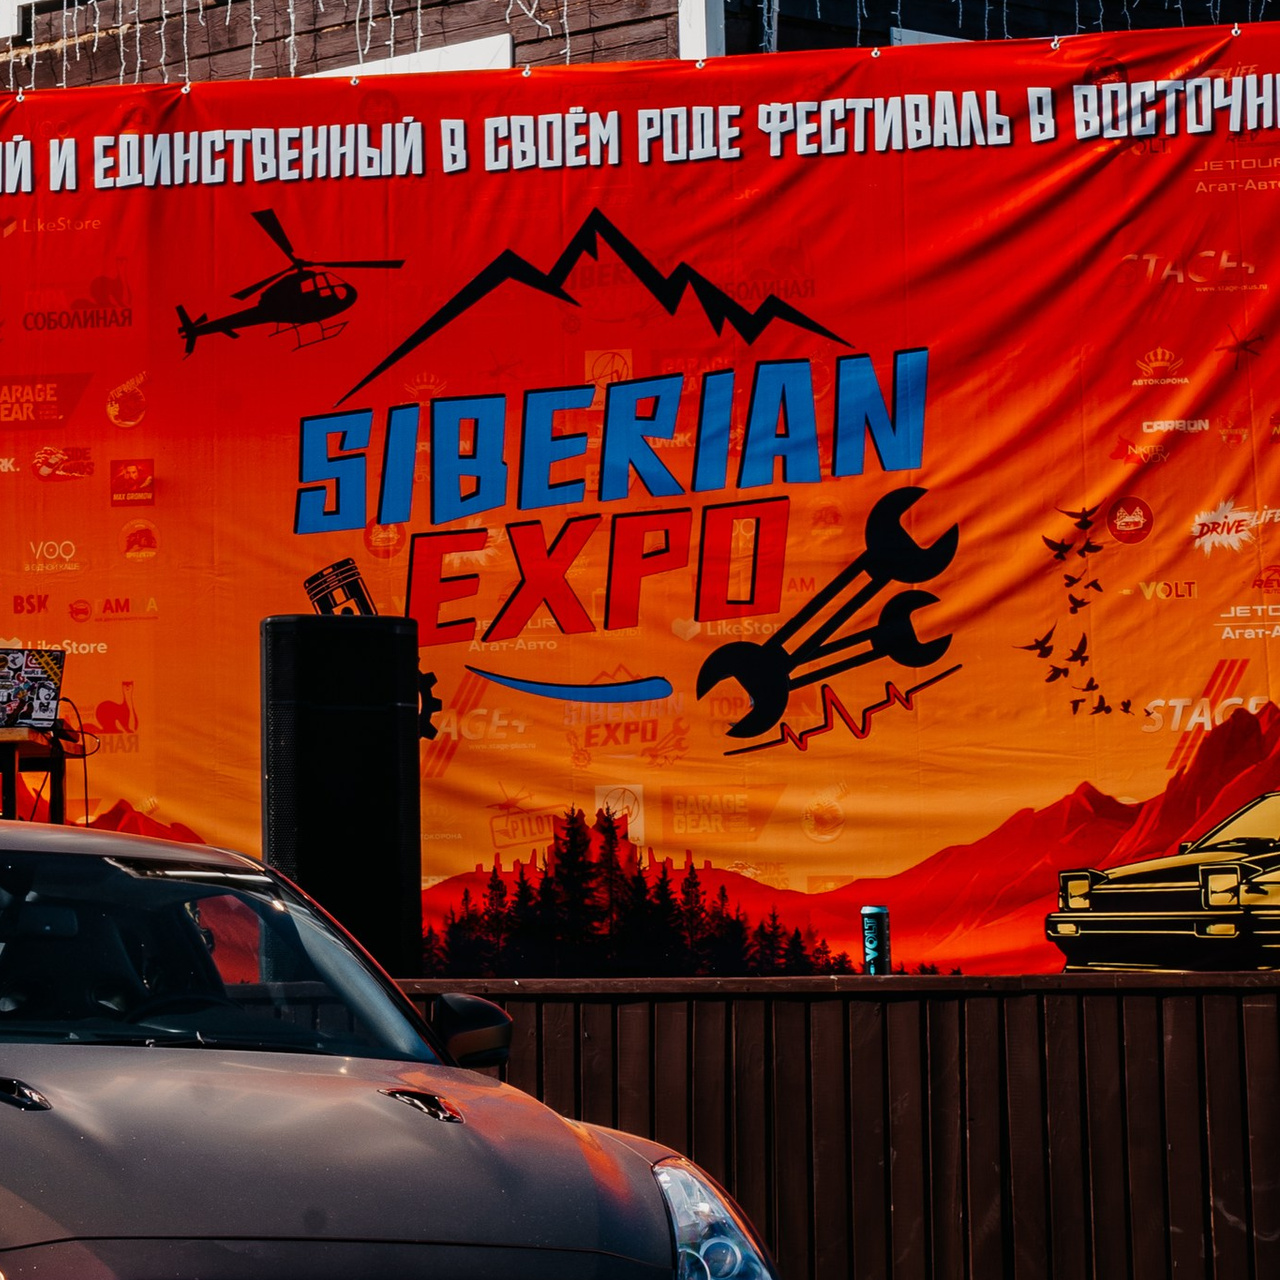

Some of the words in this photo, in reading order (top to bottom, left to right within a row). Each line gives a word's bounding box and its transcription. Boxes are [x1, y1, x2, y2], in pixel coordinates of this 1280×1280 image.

[50, 138, 76, 191] И
[94, 116, 423, 190] ЕДИНСТВЕННЫЙ
[441, 119, 467, 173] В
[485, 106, 619, 171] СВОЁМ
[638, 106, 740, 163] РОДЕ
[758, 89, 1010, 157] ФЕСТИВАЛЬ
[1028, 87, 1055, 140] В
[1074, 73, 1280, 141] ВОСТОЧН
[1195, 178, 1280, 193] Агат-Авт
[23, 307, 133, 332] СОБОЛИНАЯ
[1132, 377, 1190, 386] АВТОКОРОНА
[293, 347, 929, 535] SIBERIAN
[404, 496, 791, 649] EXPO
[1139, 581, 1198, 600] VOLT
[13, 594, 49, 615] BSK
[706, 619, 782, 637] LikeStor
[468, 639, 558, 653] Агат-Авто
[584, 718, 659, 749] EXPO
[673, 794, 748, 814] GARAGE
[673, 814, 726, 834] GEAR
[863, 917, 879, 962] VOLT
